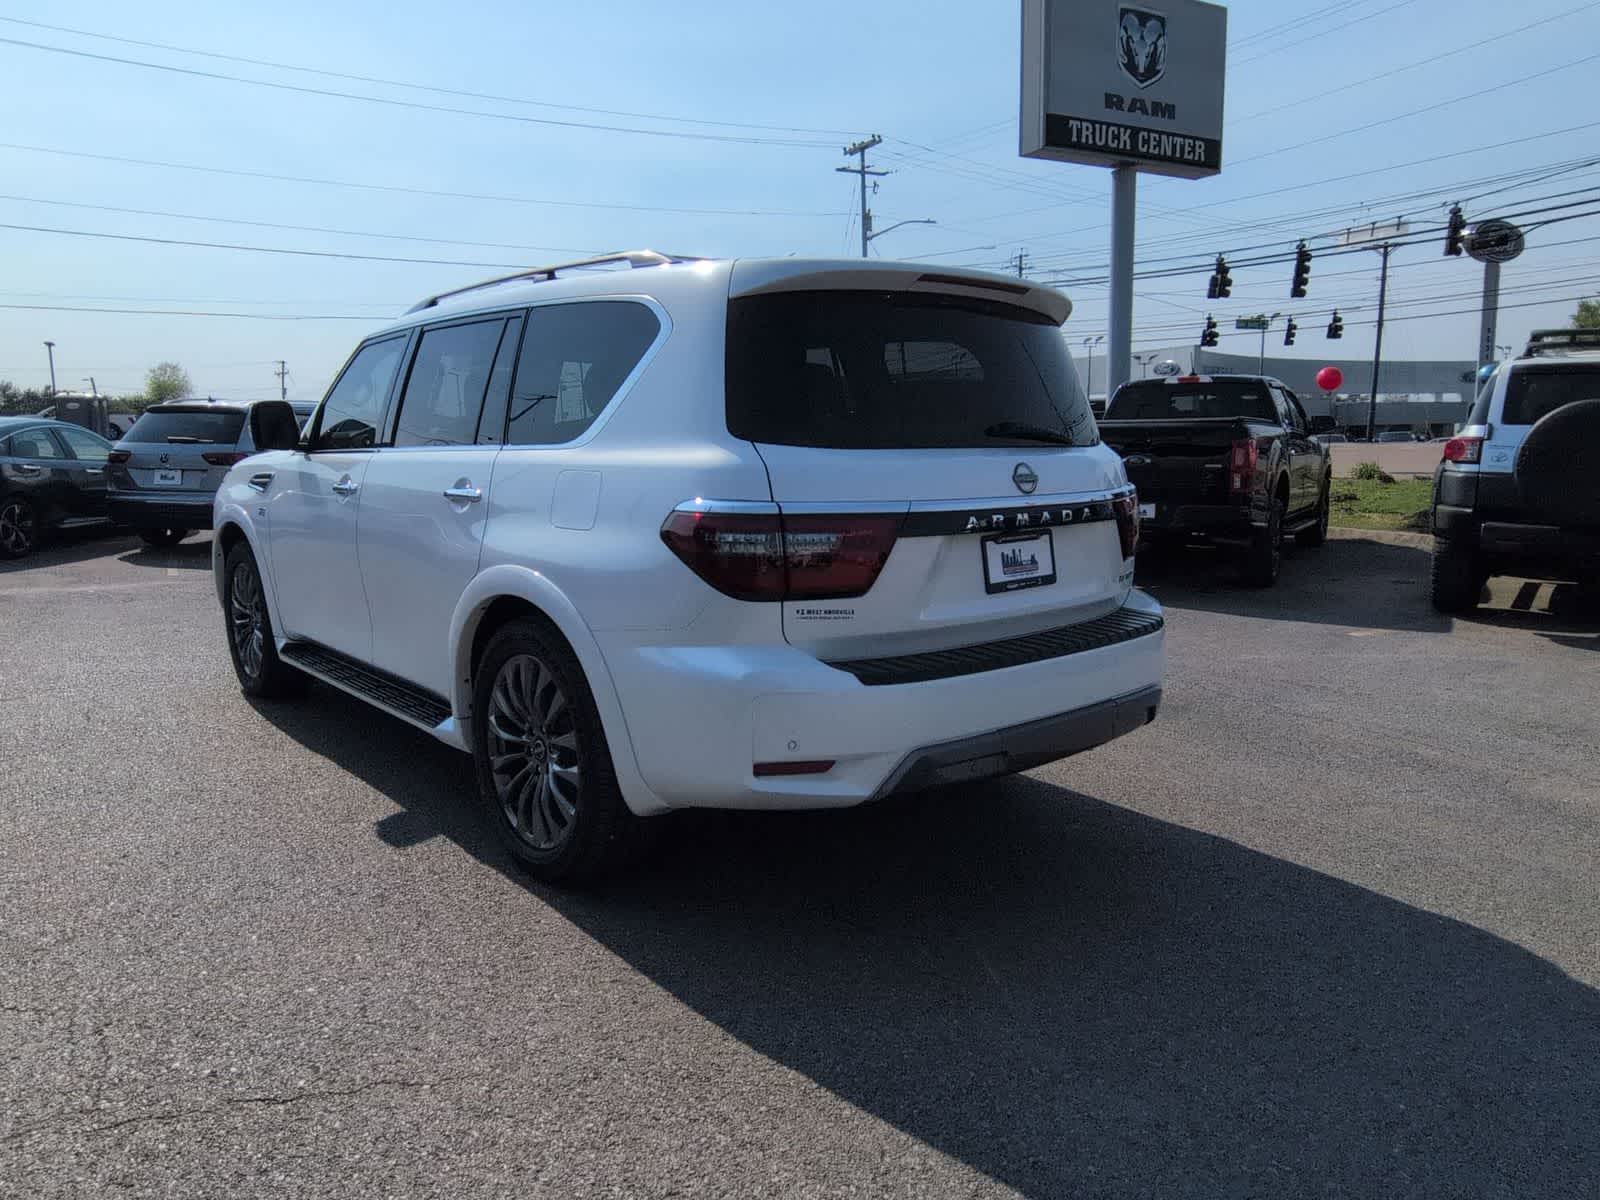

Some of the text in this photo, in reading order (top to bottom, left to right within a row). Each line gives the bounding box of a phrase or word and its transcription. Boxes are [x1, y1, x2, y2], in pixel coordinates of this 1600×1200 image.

[1104, 92, 1176, 120] RAM
[1069, 119, 1206, 162] TRUCK CENTER
[966, 507, 1091, 530] ARMADA
